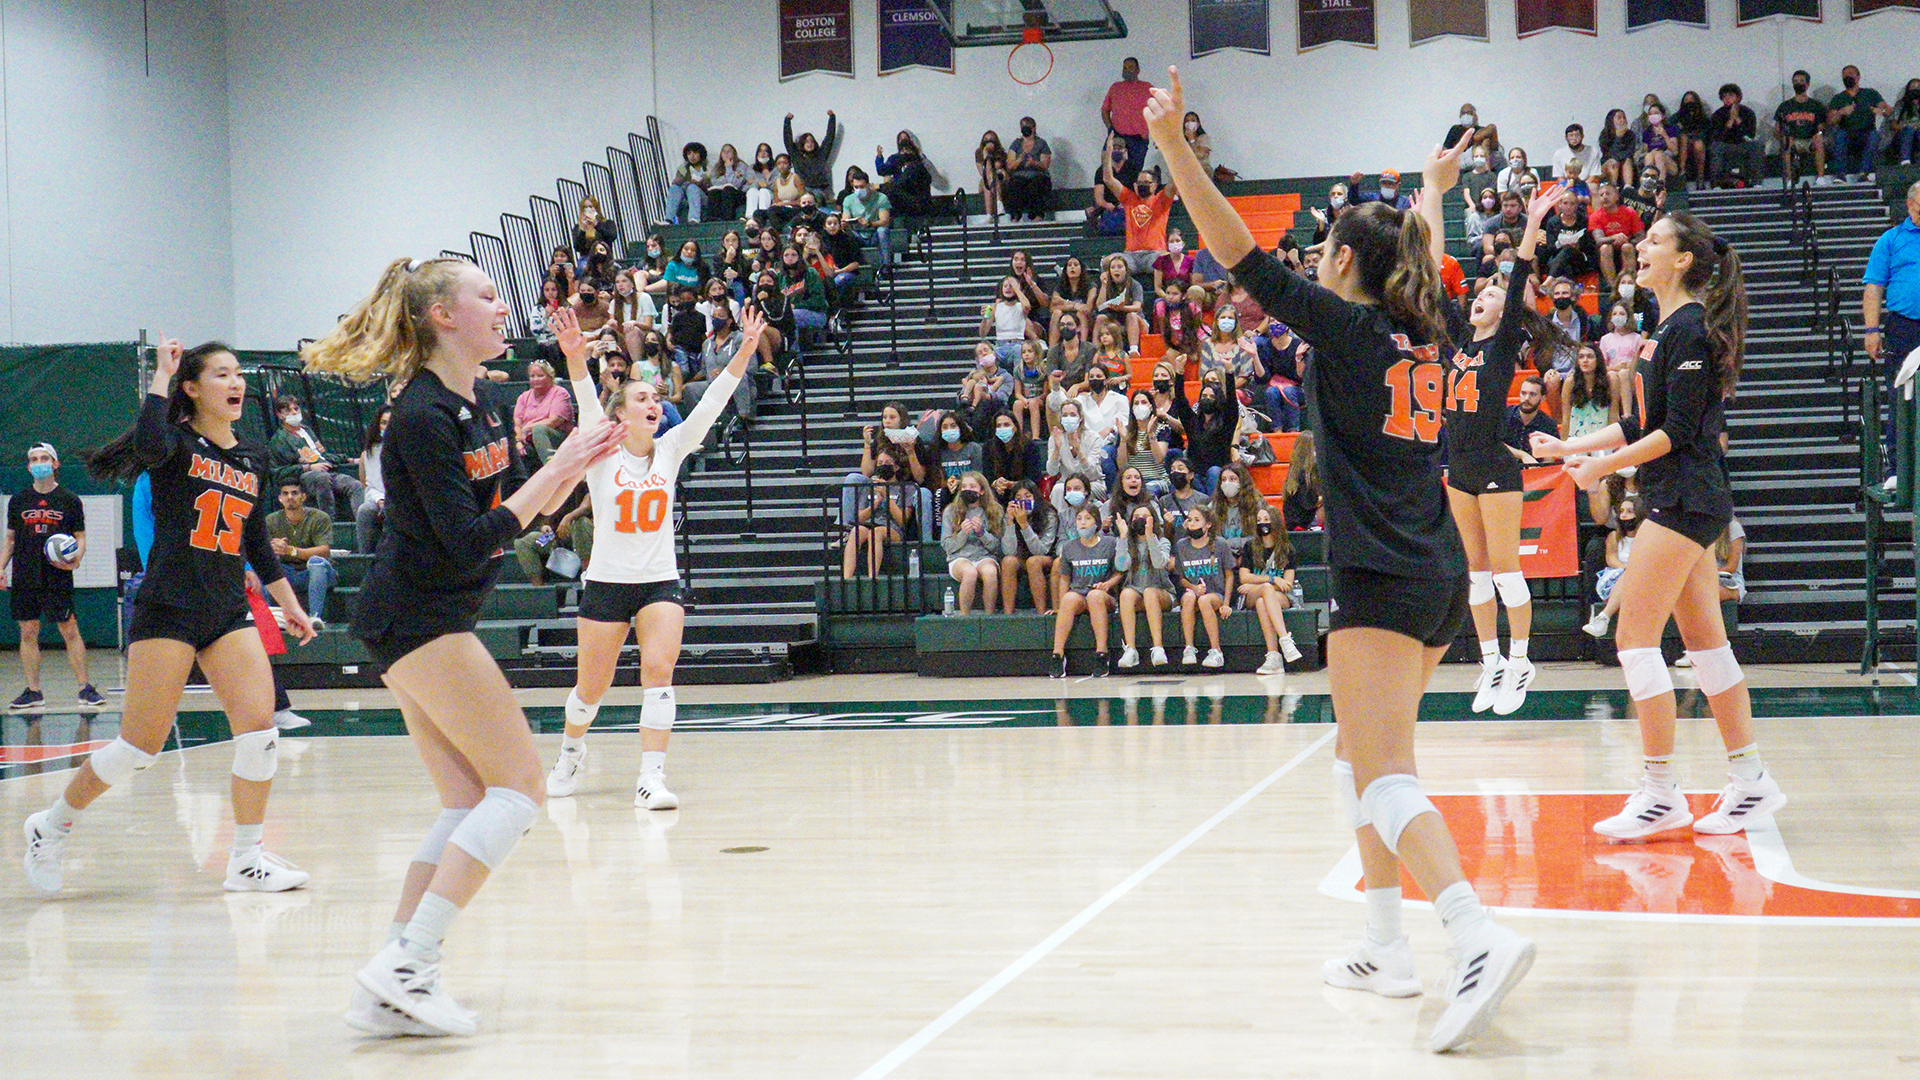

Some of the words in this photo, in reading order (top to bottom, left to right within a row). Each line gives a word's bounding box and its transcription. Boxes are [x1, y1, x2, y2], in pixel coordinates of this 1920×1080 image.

[1322, 0, 1352, 8] STATE
[794, 27, 838, 39] COLLEGE
[795, 17, 836, 28] BOSTON
[1677, 360, 1703, 370] ACC
[1383, 358, 1443, 443] 19
[1446, 368, 1480, 413] 14
[187, 453, 259, 498] MIAMI
[614, 464, 667, 489] Canes
[190, 488, 254, 556] 15
[614, 488, 669, 534] 10
